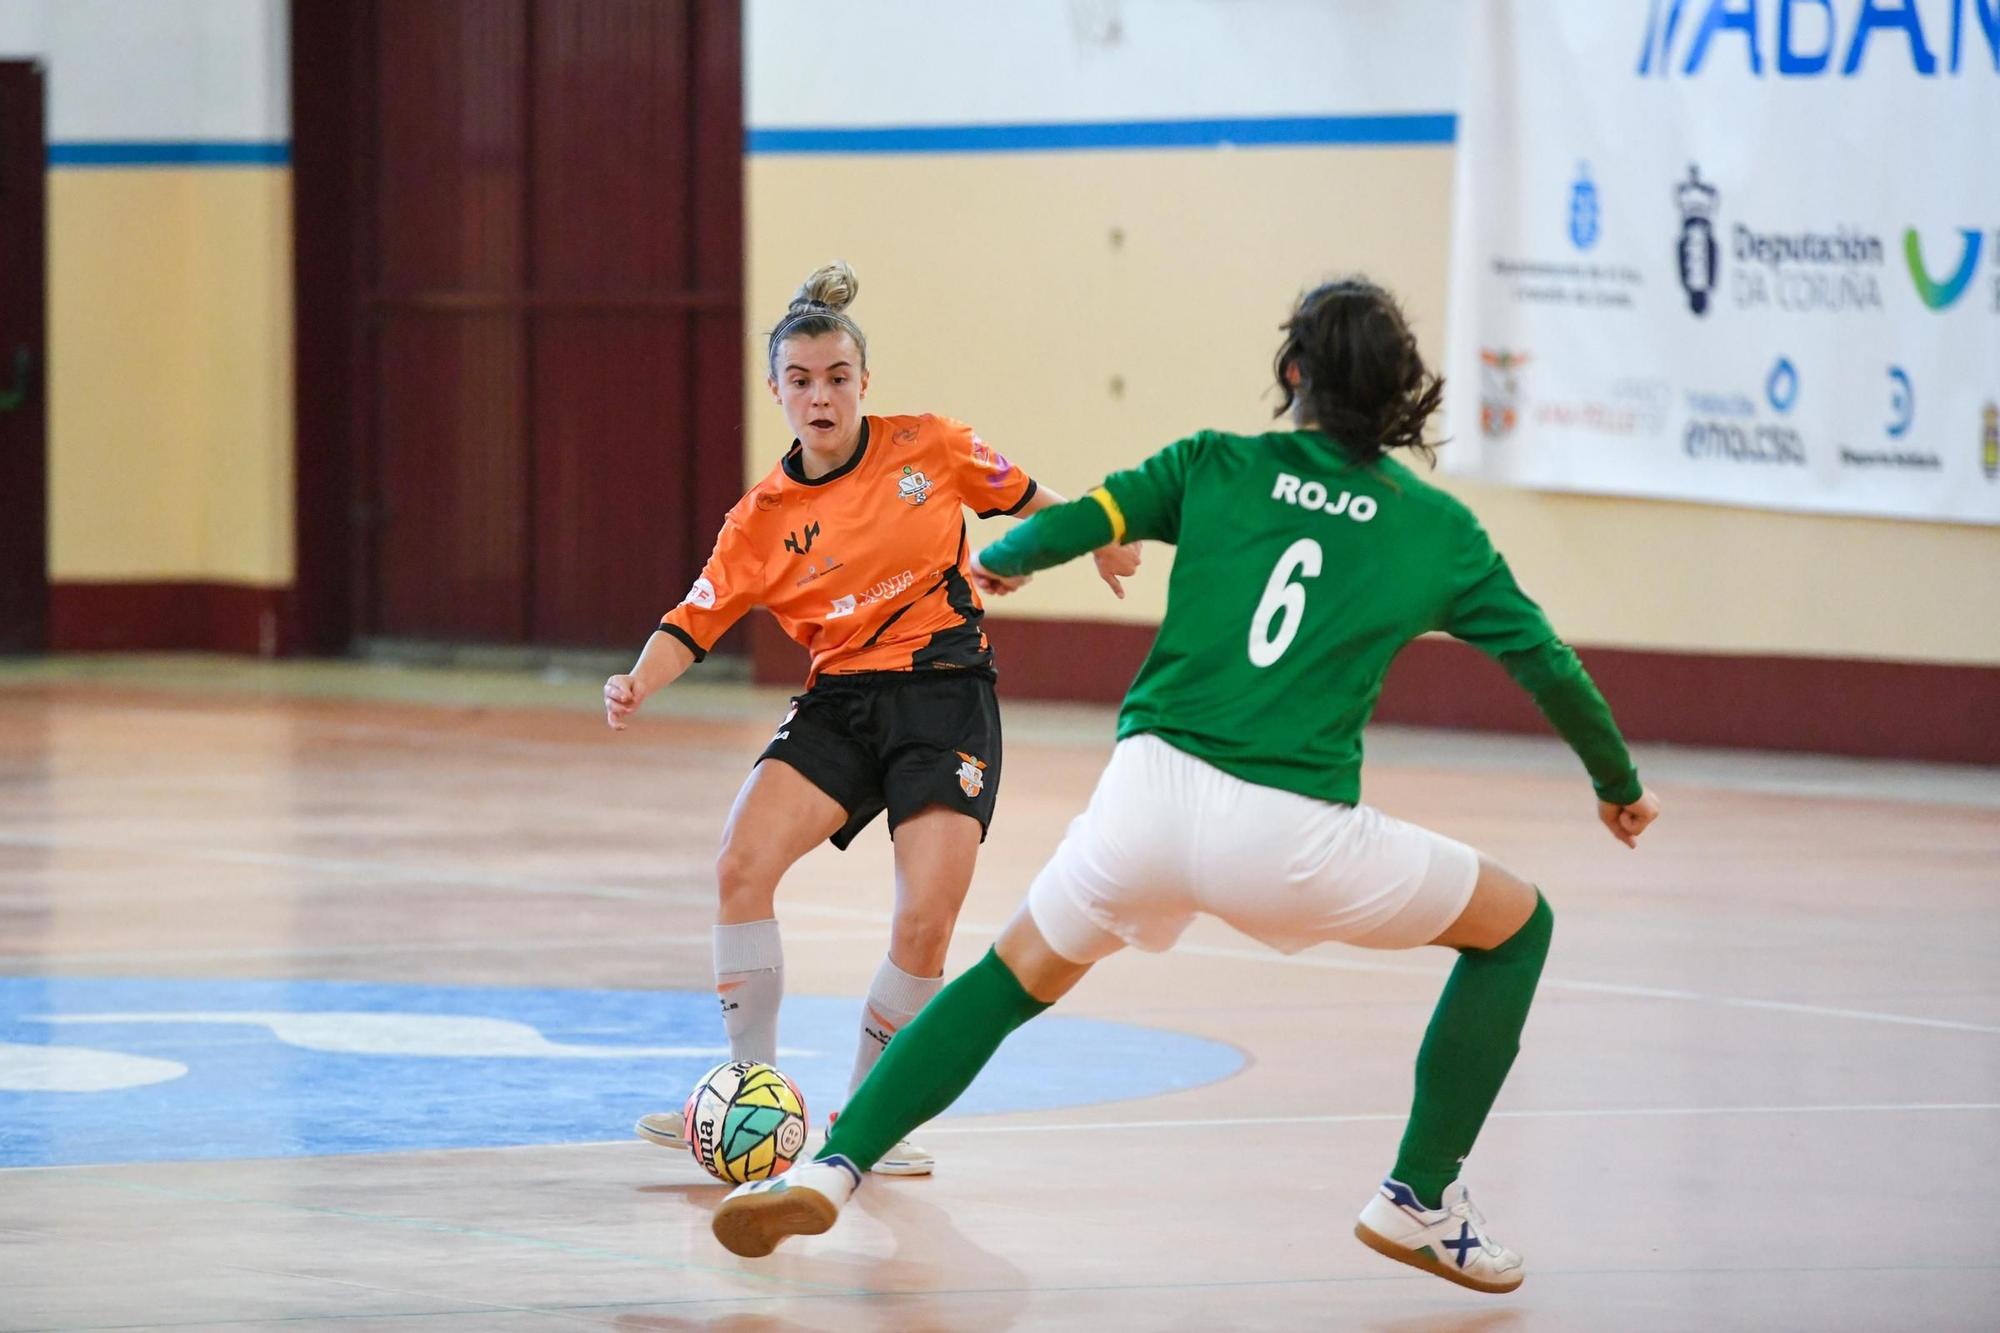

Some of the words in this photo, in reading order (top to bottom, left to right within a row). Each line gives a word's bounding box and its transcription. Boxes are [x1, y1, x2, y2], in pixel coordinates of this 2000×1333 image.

[1271, 472, 1378, 522] ROJO
[860, 569, 914, 605] XUNTA
[1248, 537, 1323, 668] 6
